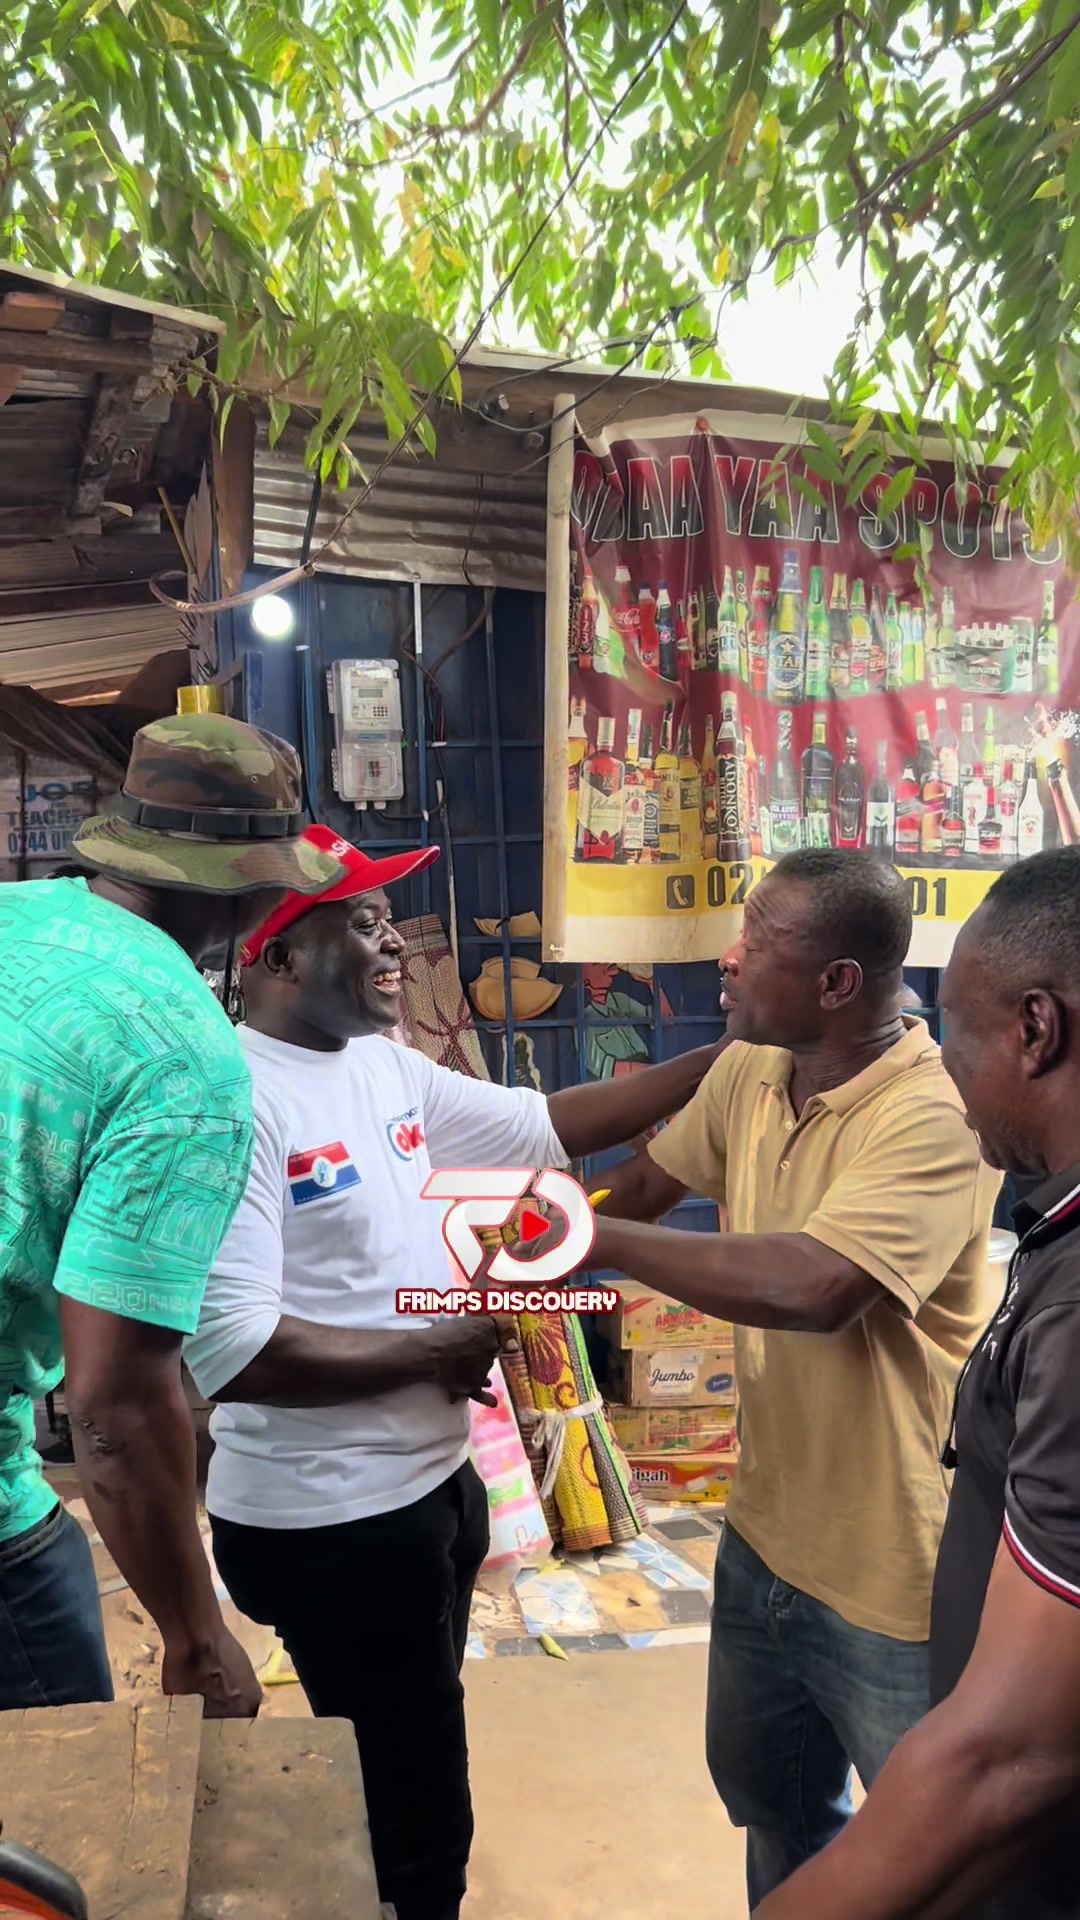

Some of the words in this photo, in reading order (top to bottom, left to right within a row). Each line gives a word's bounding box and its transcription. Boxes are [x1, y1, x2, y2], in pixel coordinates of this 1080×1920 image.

[714, 454, 840, 543] YAA
[723, 760, 738, 828] ADONKO
[648, 1367, 695, 1388] Jumbo
